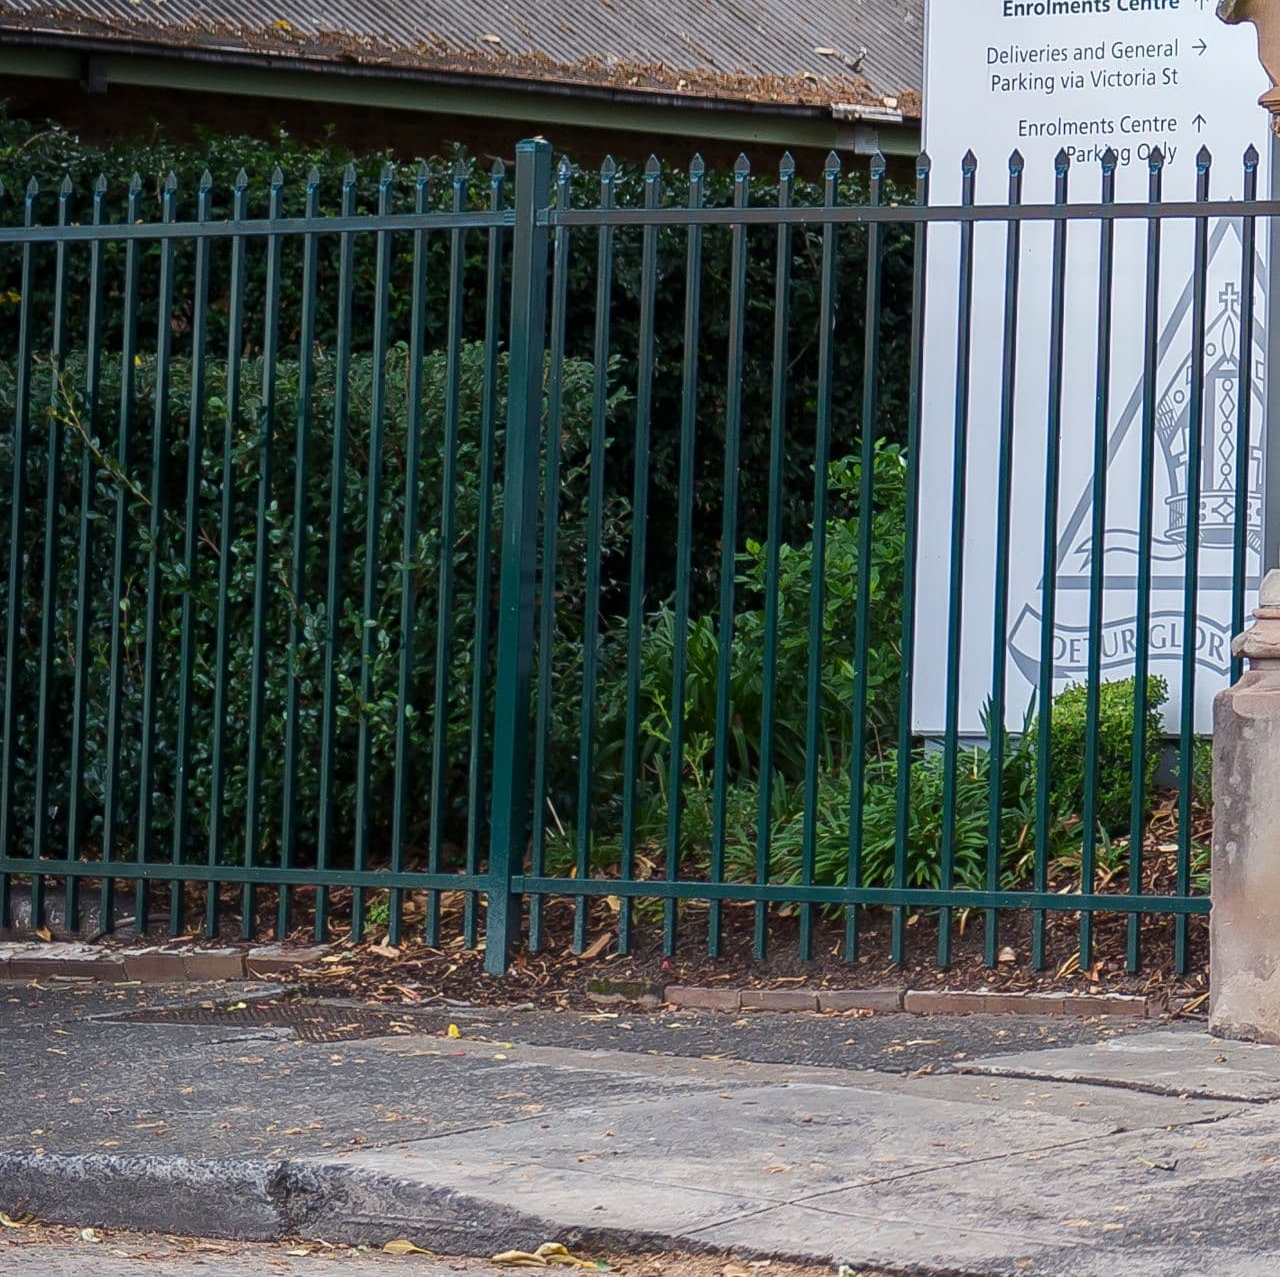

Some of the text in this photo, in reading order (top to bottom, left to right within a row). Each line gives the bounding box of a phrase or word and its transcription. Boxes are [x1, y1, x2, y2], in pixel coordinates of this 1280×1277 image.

[986, 38, 1179, 65] Deliveries and General
[991, 67, 1179, 95] Parking via Victoria St
[1018, 115, 1178, 137] Enrolments Centre
[1066, 140, 1178, 166] Parkng Oly
[1052, 628, 1137, 664] DEUR
